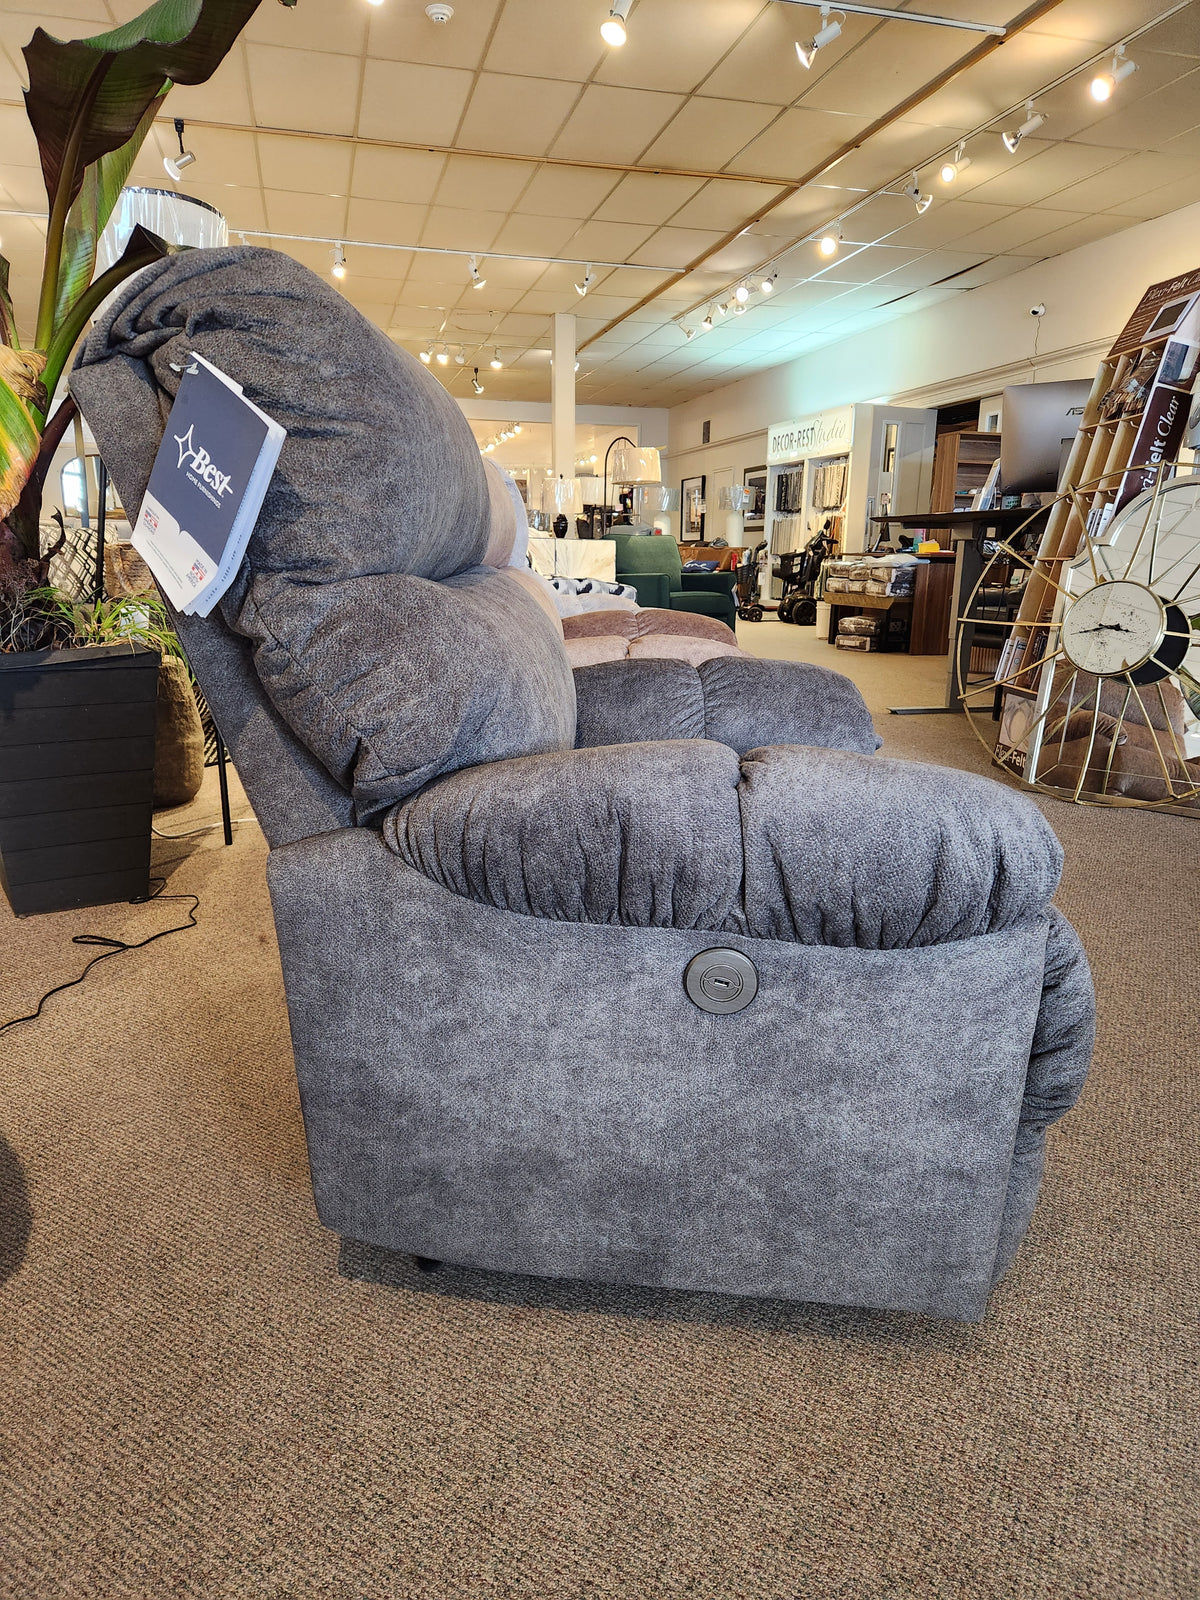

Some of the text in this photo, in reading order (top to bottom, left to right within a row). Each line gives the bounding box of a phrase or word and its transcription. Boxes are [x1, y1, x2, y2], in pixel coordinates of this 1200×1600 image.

[807, 418, 846, 451] Studio
[1157, 395, 1179, 437] Clear
[190, 446, 233, 498] Best
